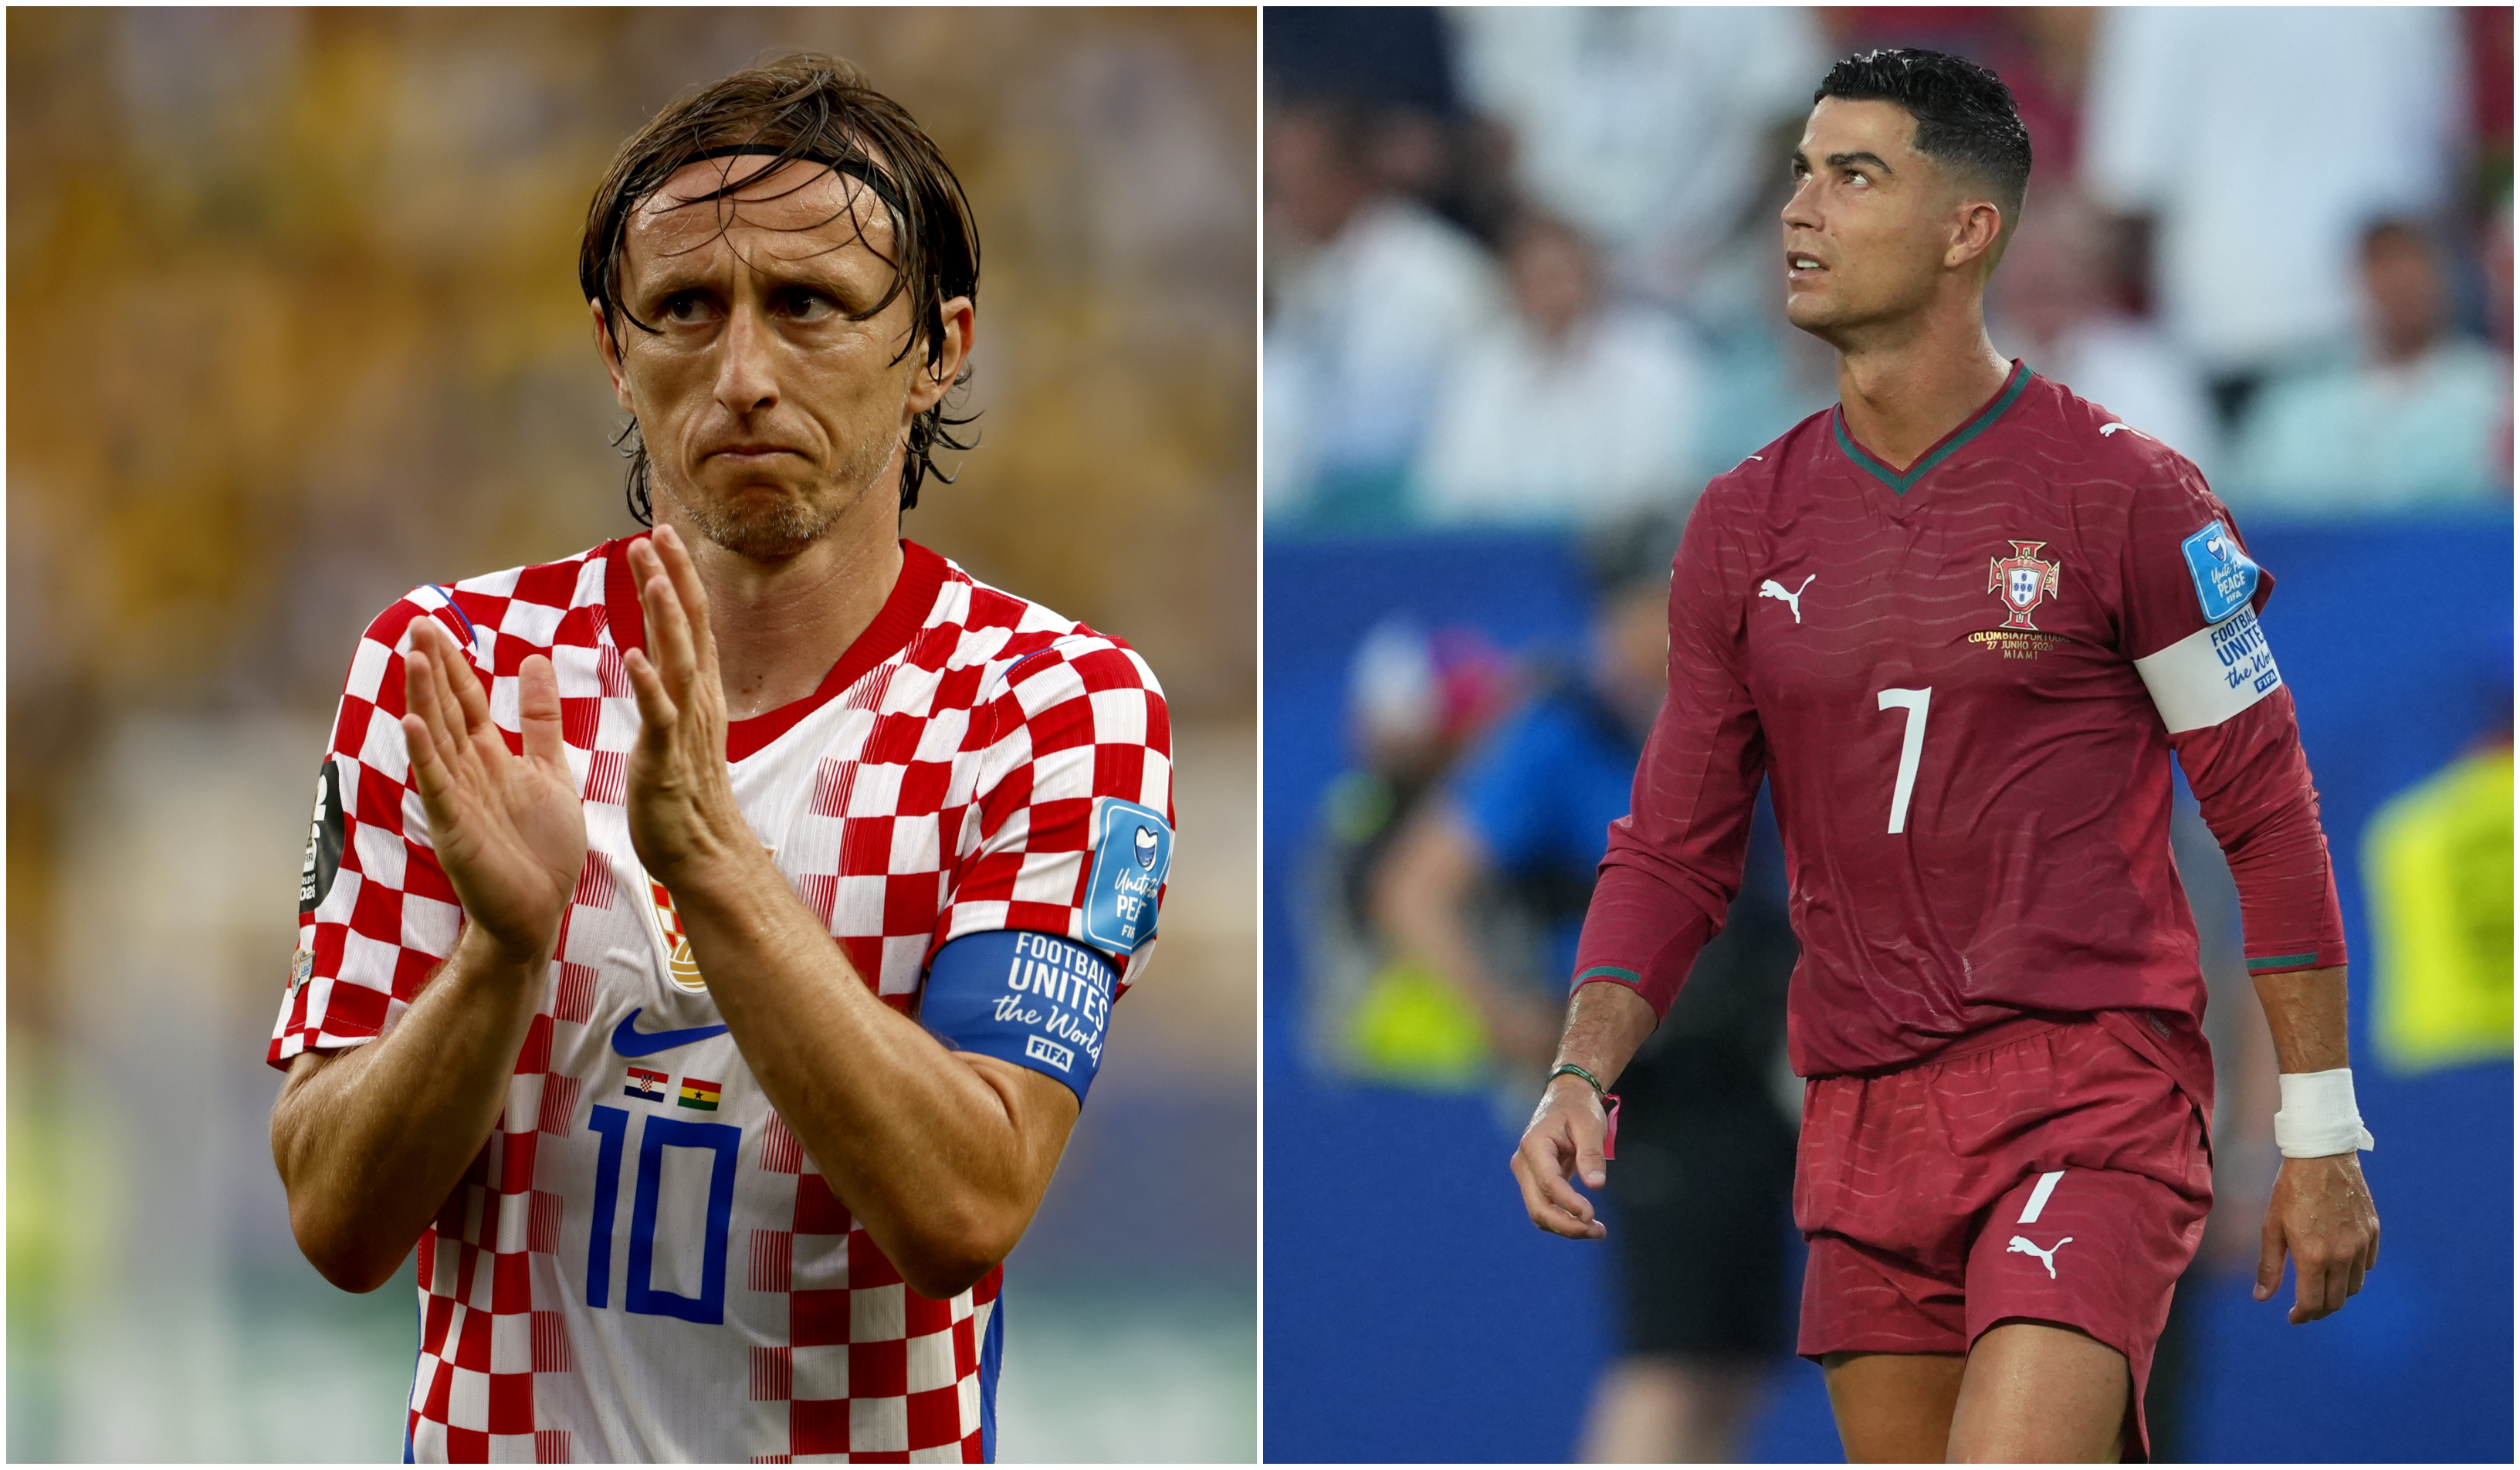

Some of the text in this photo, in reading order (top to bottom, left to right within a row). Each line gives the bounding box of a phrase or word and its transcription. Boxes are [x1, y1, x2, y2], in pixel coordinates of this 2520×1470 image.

[2217, 571, 2246, 598] PEACE
[2227, 590, 2242, 604] FIFA
[1987, 641, 2054, 651] 27 JUNHO 2026
[2003, 649, 2037, 660] MIAMI
[2216, 622, 2264, 666] UNITE
[2224, 650, 2273, 689] the Wor
[2255, 672, 2277, 692] FIFA
[1877, 686, 1932, 834] 7
[300, 883, 316, 902] 026
[1015, 931, 1111, 1000] FOOTBALL
[1008, 957, 1108, 1032] UNITES
[992, 994, 1102, 1068] the World
[1029, 1038, 1071, 1070] FIFA
[586, 1104, 742, 1326] 10
